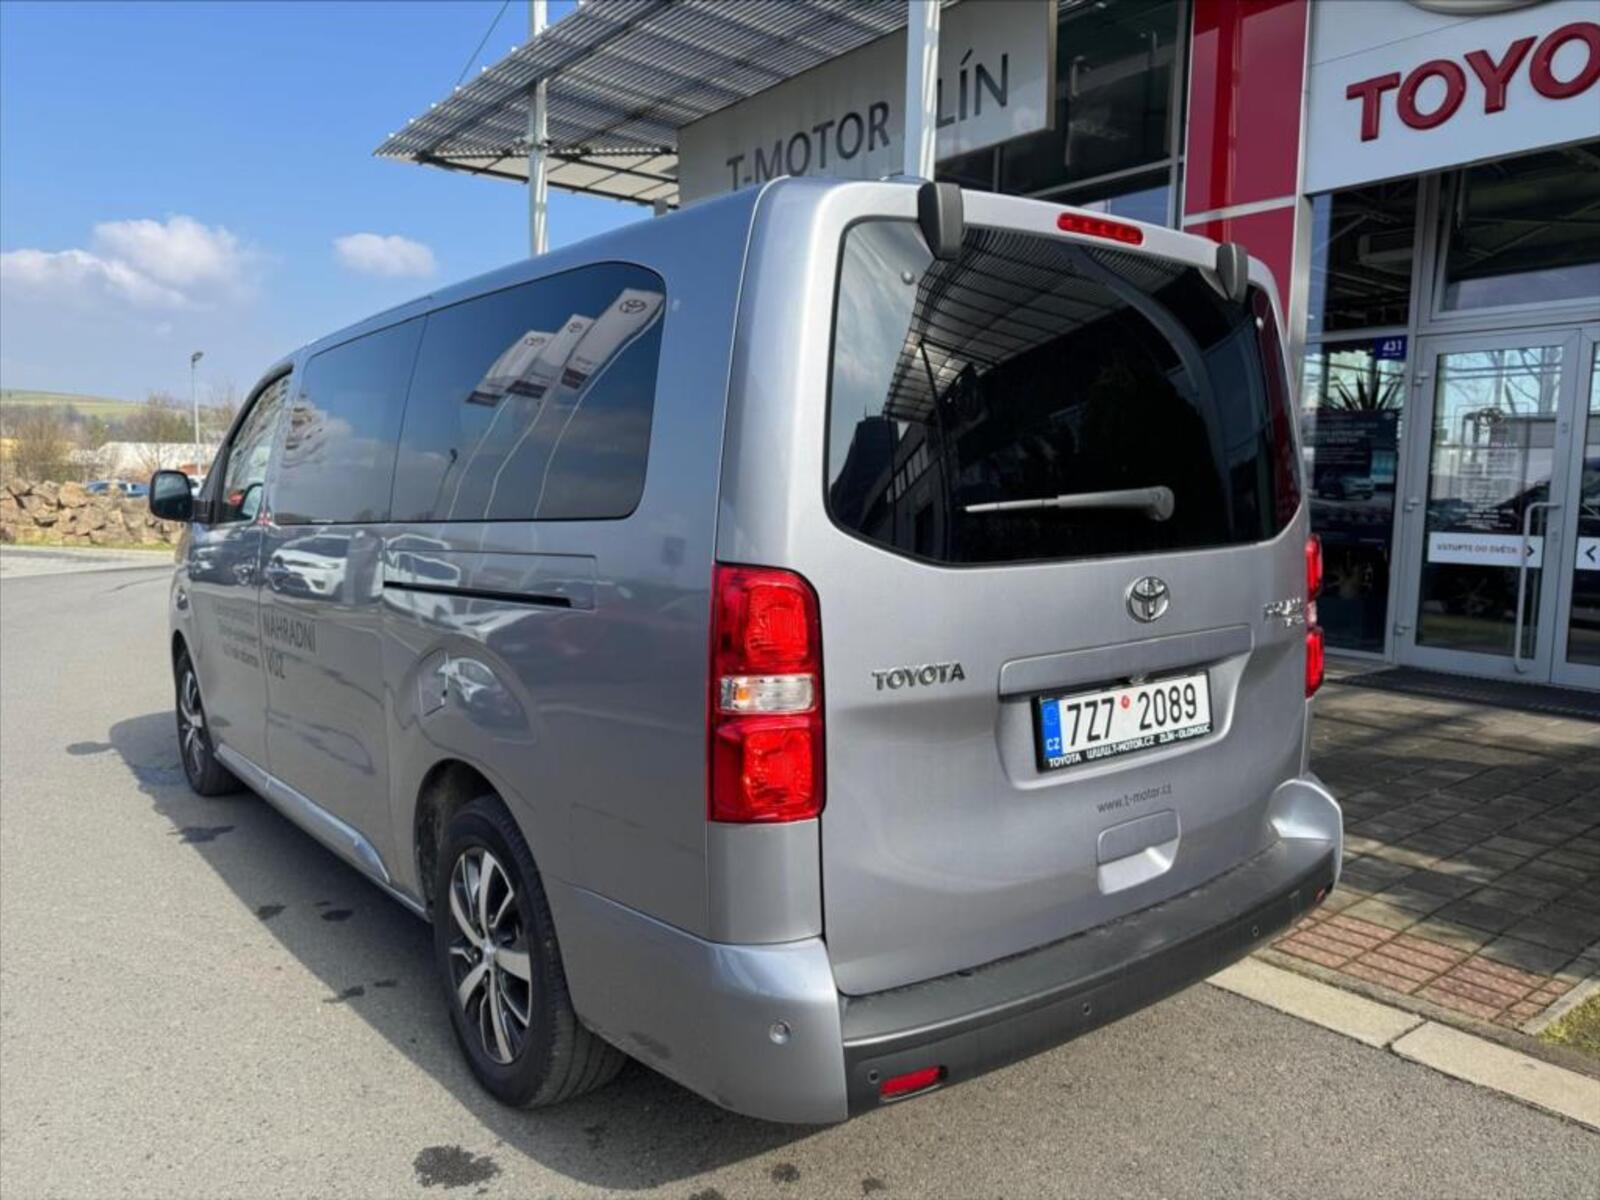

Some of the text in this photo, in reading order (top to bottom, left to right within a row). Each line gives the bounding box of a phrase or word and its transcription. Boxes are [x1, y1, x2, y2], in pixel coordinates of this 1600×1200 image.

[1346, 22, 1600, 142] TOYO
[726, 48, 1009, 190] T-MOTOR LÍN
[1383, 340, 1401, 351] 431
[871, 662, 965, 691] TOYOTA
[1067, 682, 1197, 746] 7Z7 2089
[1046, 737, 1060, 751] CZ
[1048, 752, 1081, 768] TOYOTA
